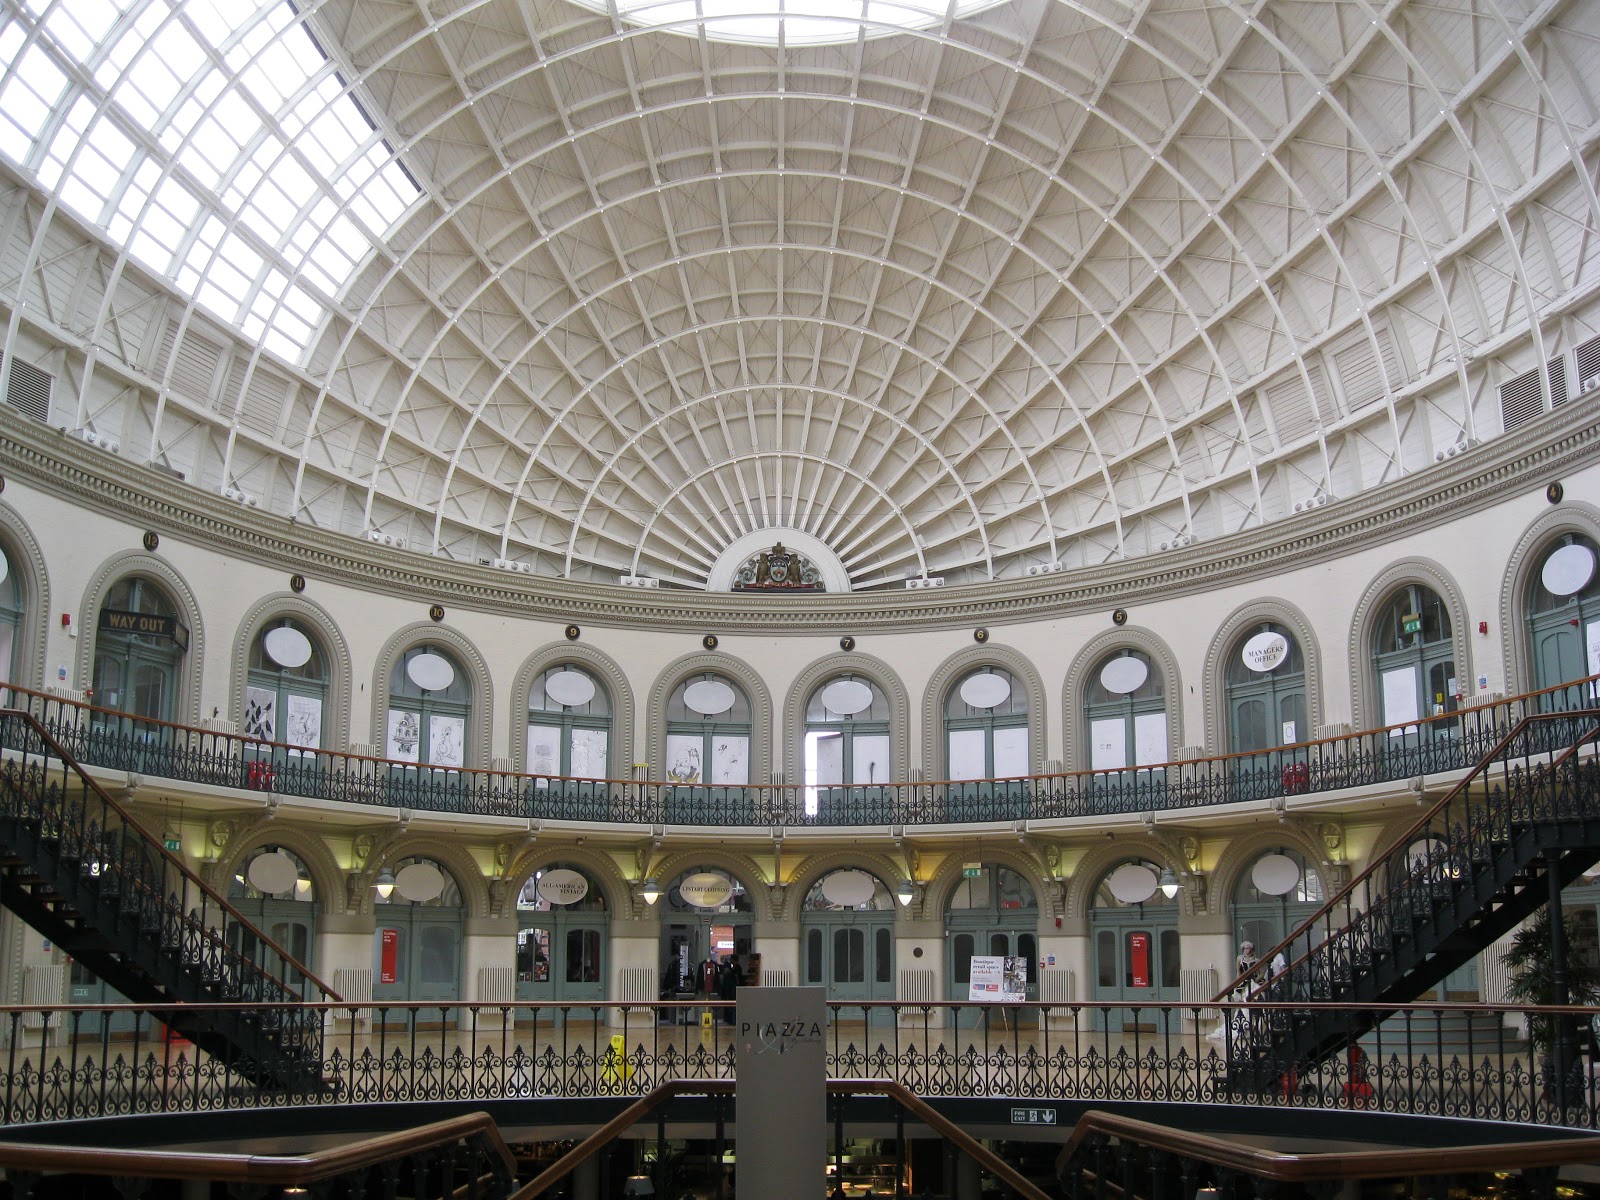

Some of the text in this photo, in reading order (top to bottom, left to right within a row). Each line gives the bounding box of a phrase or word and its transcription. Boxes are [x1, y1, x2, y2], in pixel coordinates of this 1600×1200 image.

[1550, 486, 1557, 498] 4
[147, 534, 157, 547] 12
[295, 577, 302, 588] 11
[433, 607, 443, 617] 10
[1116, 612, 1122, 621] 5
[110, 614, 165, 632] WAY OUT
[570, 627, 577, 637] 9
[977, 630, 984, 639] 6
[707, 637, 714, 646] 8
[844, 639, 851, 648] 7
[1248, 645, 1283, 657] MANAGERS
[1254, 654, 1277, 663] OFFICE
[541, 882, 585, 890] ALL-AMERICAN
[742, 1022, 821, 1036] PIAZZA
